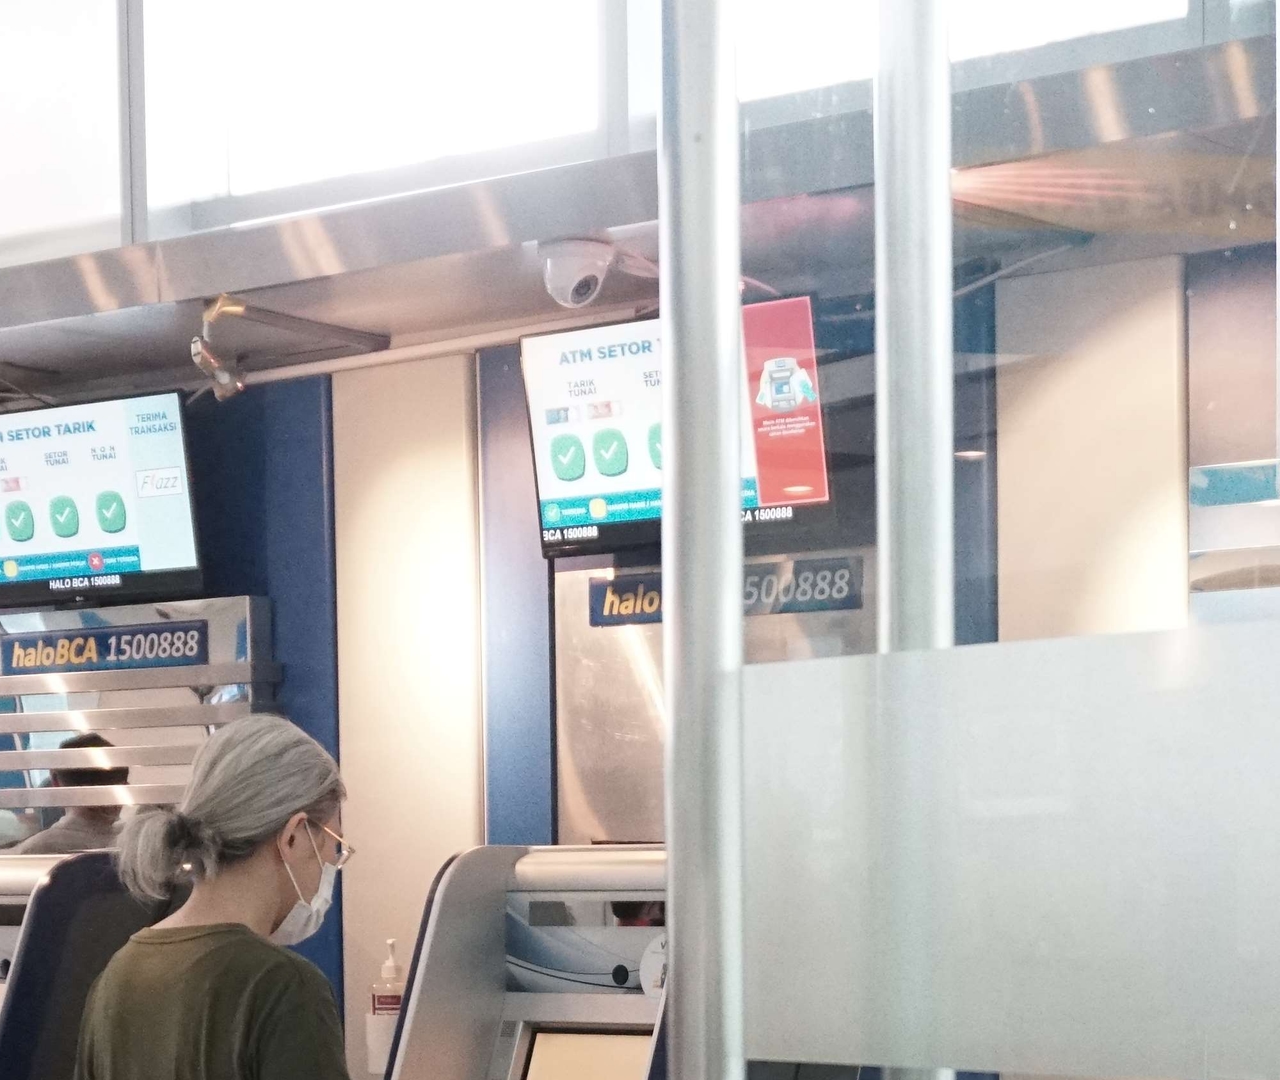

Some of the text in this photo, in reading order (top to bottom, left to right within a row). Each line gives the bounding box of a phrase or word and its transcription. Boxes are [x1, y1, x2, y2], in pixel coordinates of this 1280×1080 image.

[559, 349, 593, 366] ATM
[598, 340, 653, 360] SETOR
[567, 379, 595, 390] TARIK
[568, 387, 597, 398] TUNAI
[136, 411, 168, 423] TERIMA
[7, 424, 51, 442] SETOR
[56, 420, 96, 436] TARIK
[129, 422, 177, 436] TRANSAKSI
[44, 451, 67, 460] SETOR
[45, 457, 69, 467] TUNAI
[92, 452, 117, 461] TUNAI
[754, 506, 793, 521] 1500888
[563, 525, 598, 539] 1500888
[49, 578, 71, 590] HALO
[72, 577, 90, 588] BCA
[743, 568, 850, 605] 500888
[11, 630, 200, 669] haloBCA 1500888
